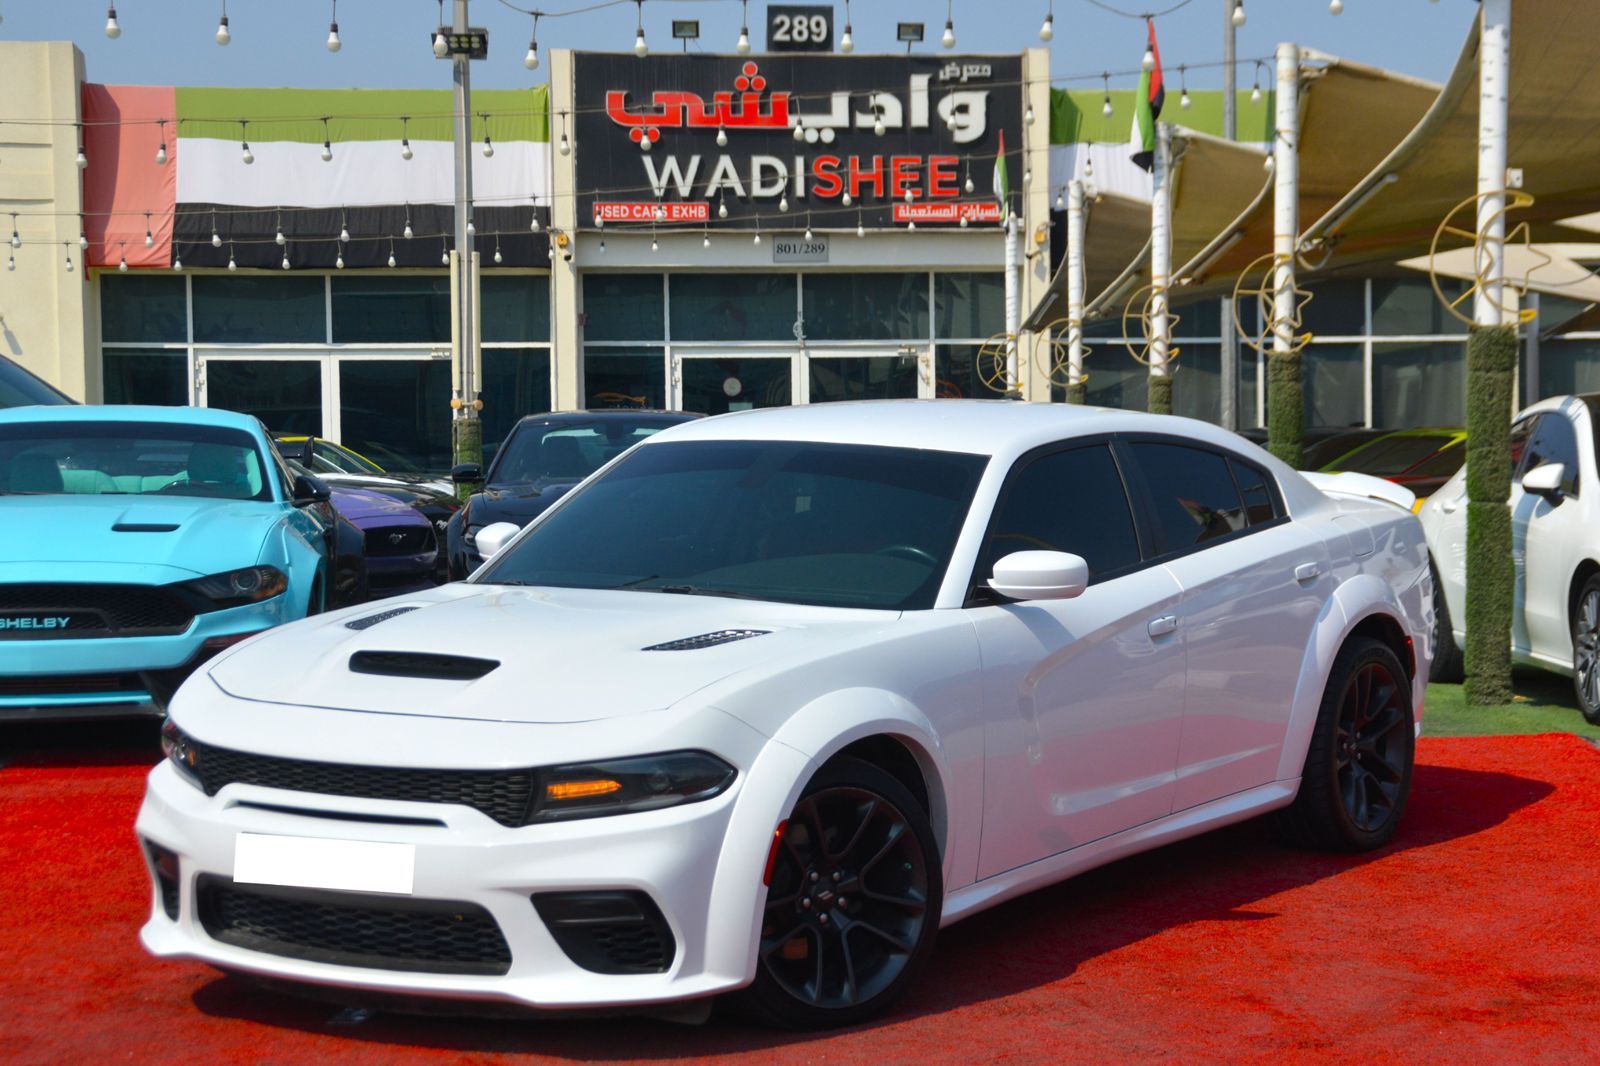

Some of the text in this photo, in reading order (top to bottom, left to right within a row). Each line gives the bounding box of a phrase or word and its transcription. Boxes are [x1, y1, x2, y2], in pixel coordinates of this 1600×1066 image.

[773, 14, 827, 43] 289
[939, 62, 992, 82] معرض
[641, 154, 960, 198] WADISHEE
[672, 205, 707, 218] EXHB
[898, 204, 1003, 220] لسيارات المستعملة
[776, 243, 825, 255] 801/289
